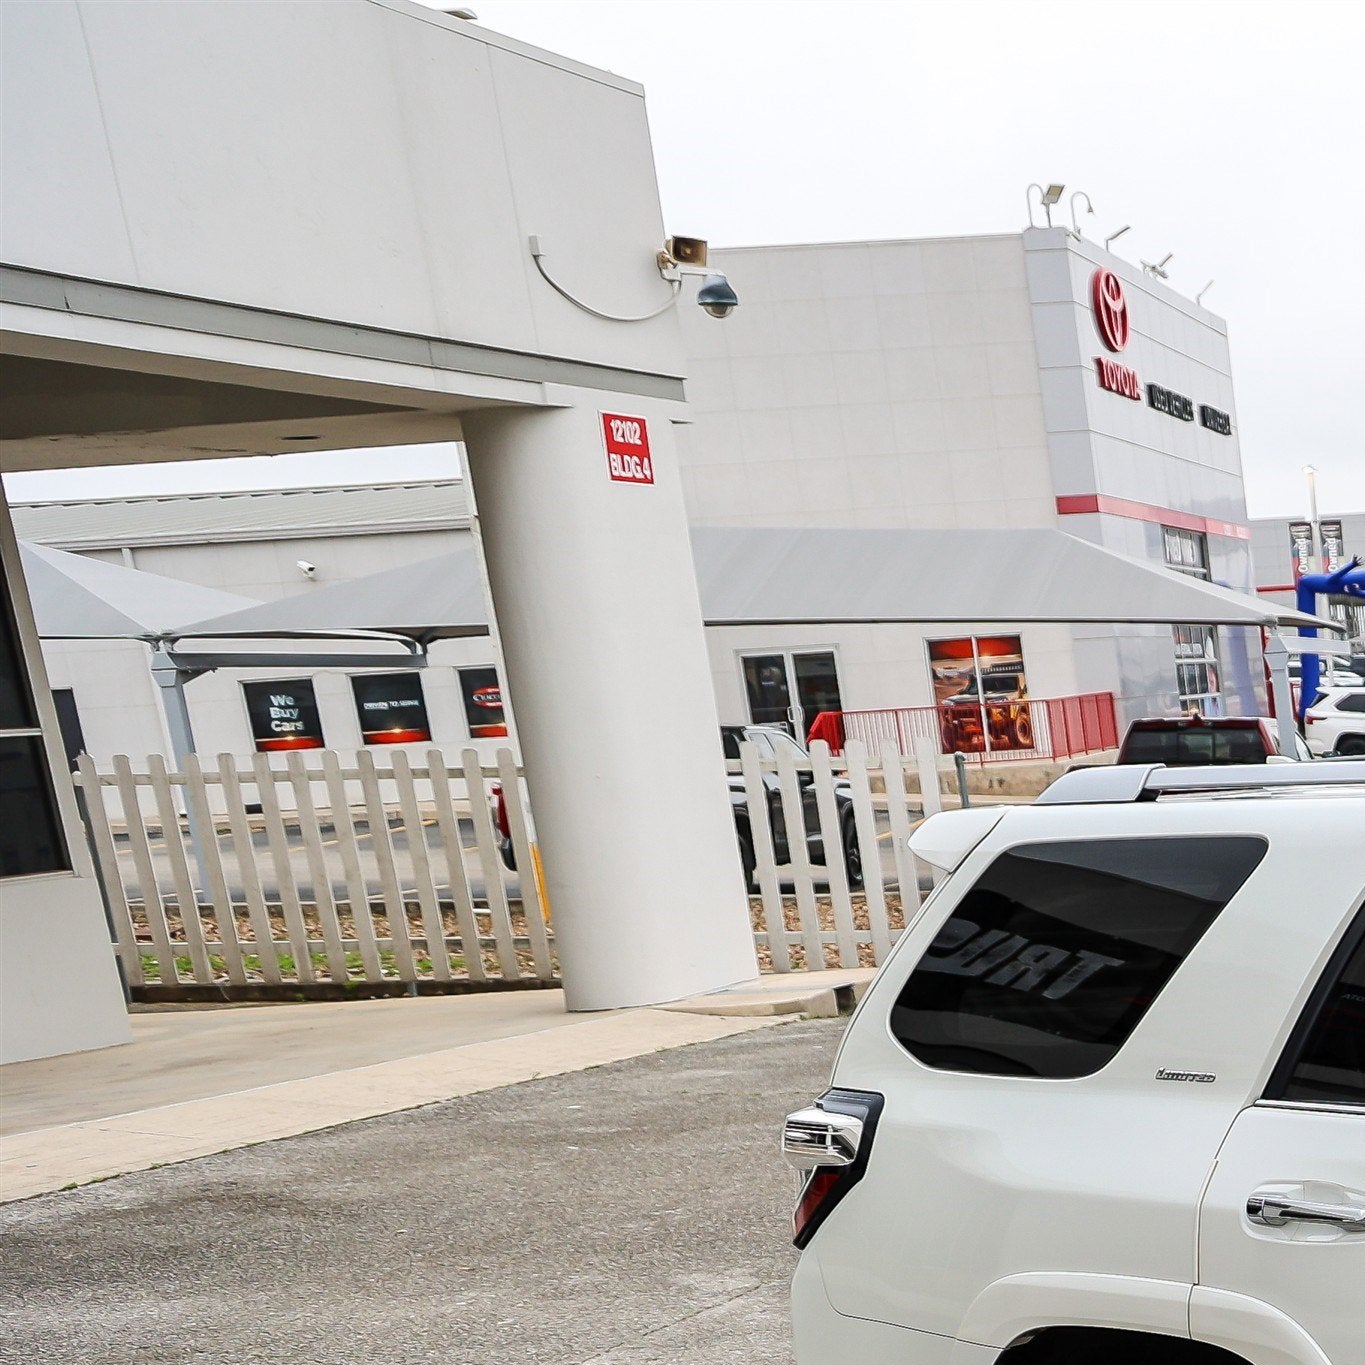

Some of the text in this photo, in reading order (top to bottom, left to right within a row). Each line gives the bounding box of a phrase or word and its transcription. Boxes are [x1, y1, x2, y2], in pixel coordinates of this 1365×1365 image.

[1096, 356, 1142, 401] TOYOTA
[610, 419, 643, 446] 12102
[270, 694, 295, 707] We
[271, 719, 305, 732] Cars
